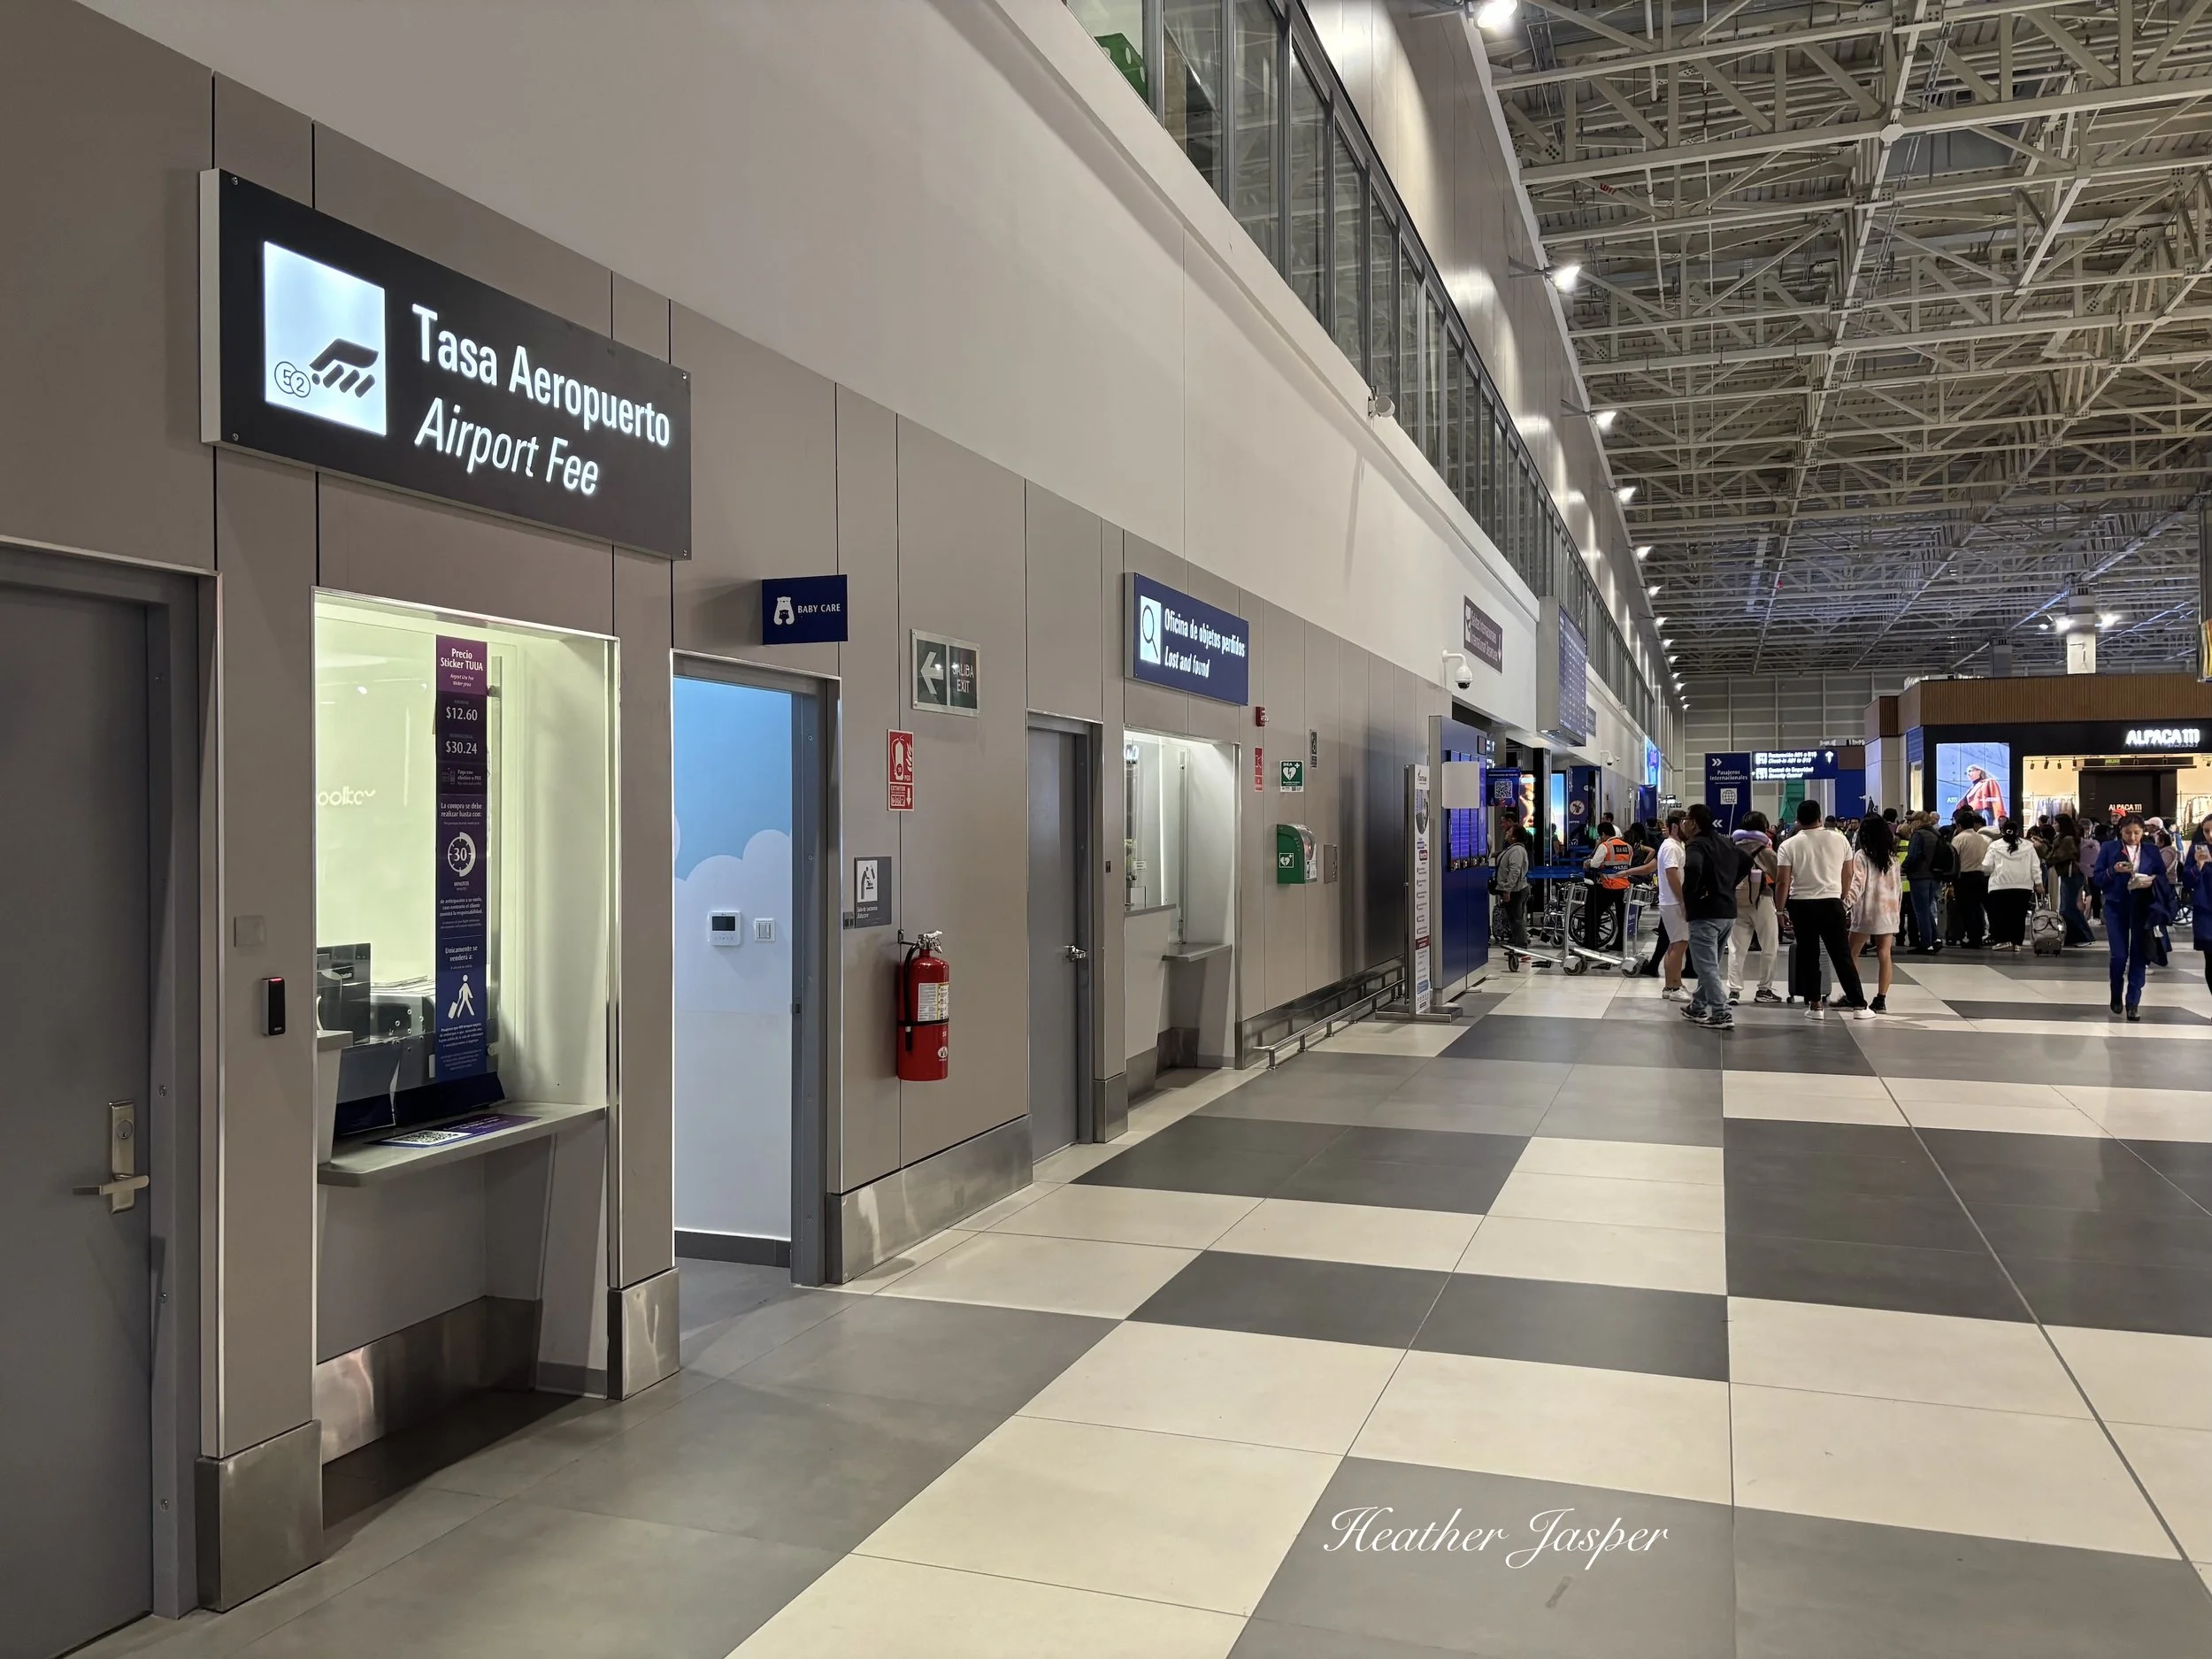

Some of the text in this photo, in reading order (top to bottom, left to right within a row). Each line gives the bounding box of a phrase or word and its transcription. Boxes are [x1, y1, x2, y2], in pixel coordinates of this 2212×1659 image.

[281, 367, 305, 393] 5 2
[412, 303, 671, 448] Tasa Aeropuerto
[415, 397, 600, 495] Airport Fee
[797, 603, 841, 614] BABY CARE
[1164, 608, 1245, 657] Oficina de objetos perdidos
[451, 648, 472, 659] Precio
[440, 657, 483, 672] Sticker TUUA
[1164, 645, 1210, 678] Lost and found
[956, 679, 971, 693] EXIT
[446, 706, 478, 721] $12.60
[2125, 729, 2182, 745] ALPACA
[446, 741, 478, 755] $30.24
[453, 847, 467, 862] 30
